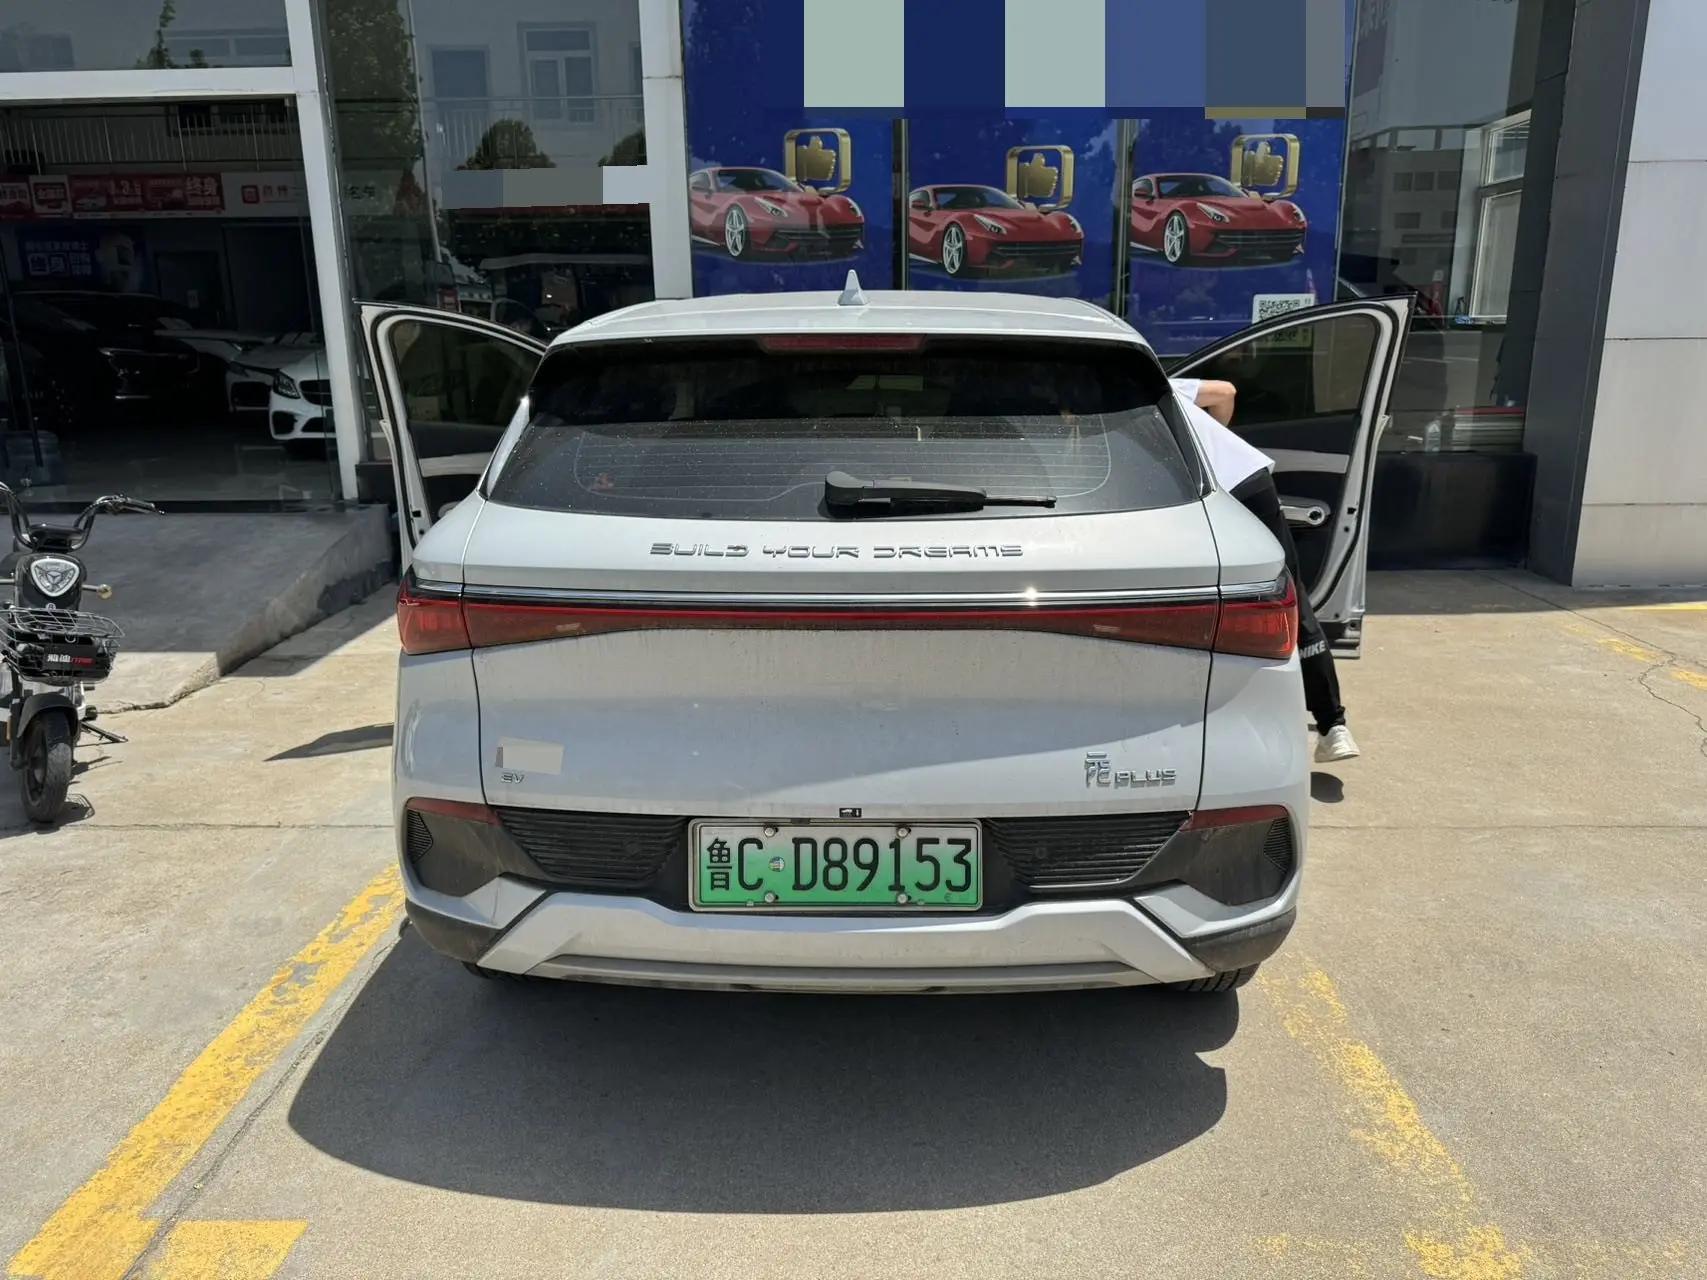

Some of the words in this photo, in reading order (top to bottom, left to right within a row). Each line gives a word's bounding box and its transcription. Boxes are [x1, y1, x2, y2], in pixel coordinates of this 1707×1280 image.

[650, 542, 749, 557] BUILD
[762, 544, 860, 558] YOUR
[873, 545, 1024, 558] DREAMS
